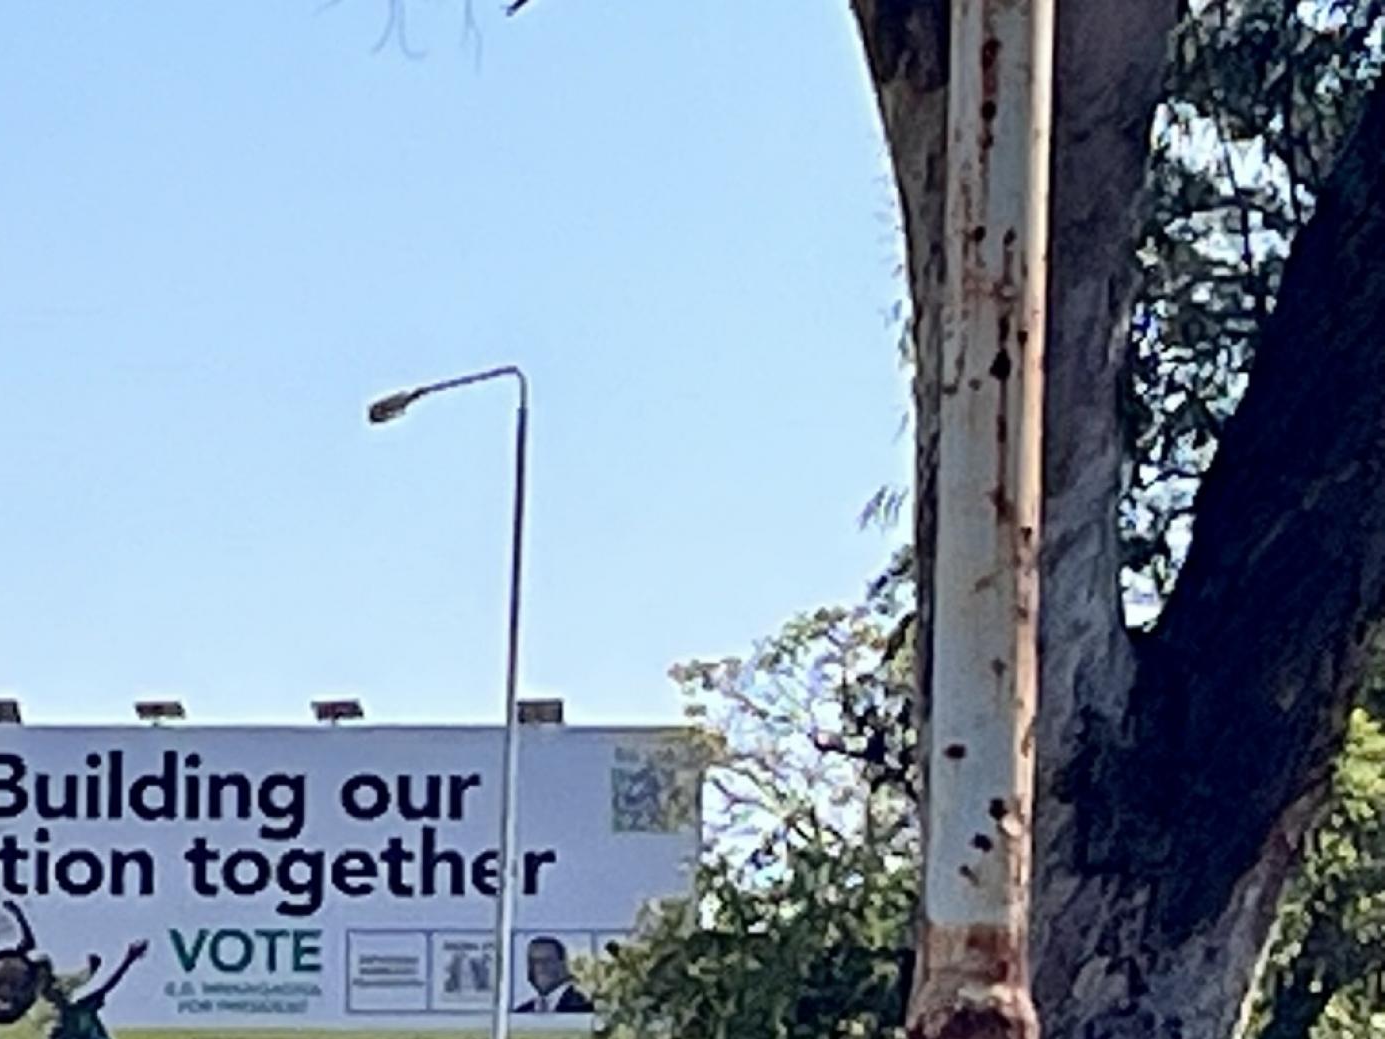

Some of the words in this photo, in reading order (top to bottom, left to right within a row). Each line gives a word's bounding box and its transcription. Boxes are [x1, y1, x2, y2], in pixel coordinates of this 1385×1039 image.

[340, 773, 481, 821] our
[184, 826, 557, 917] together
[168, 928, 323, 974] VOTE
